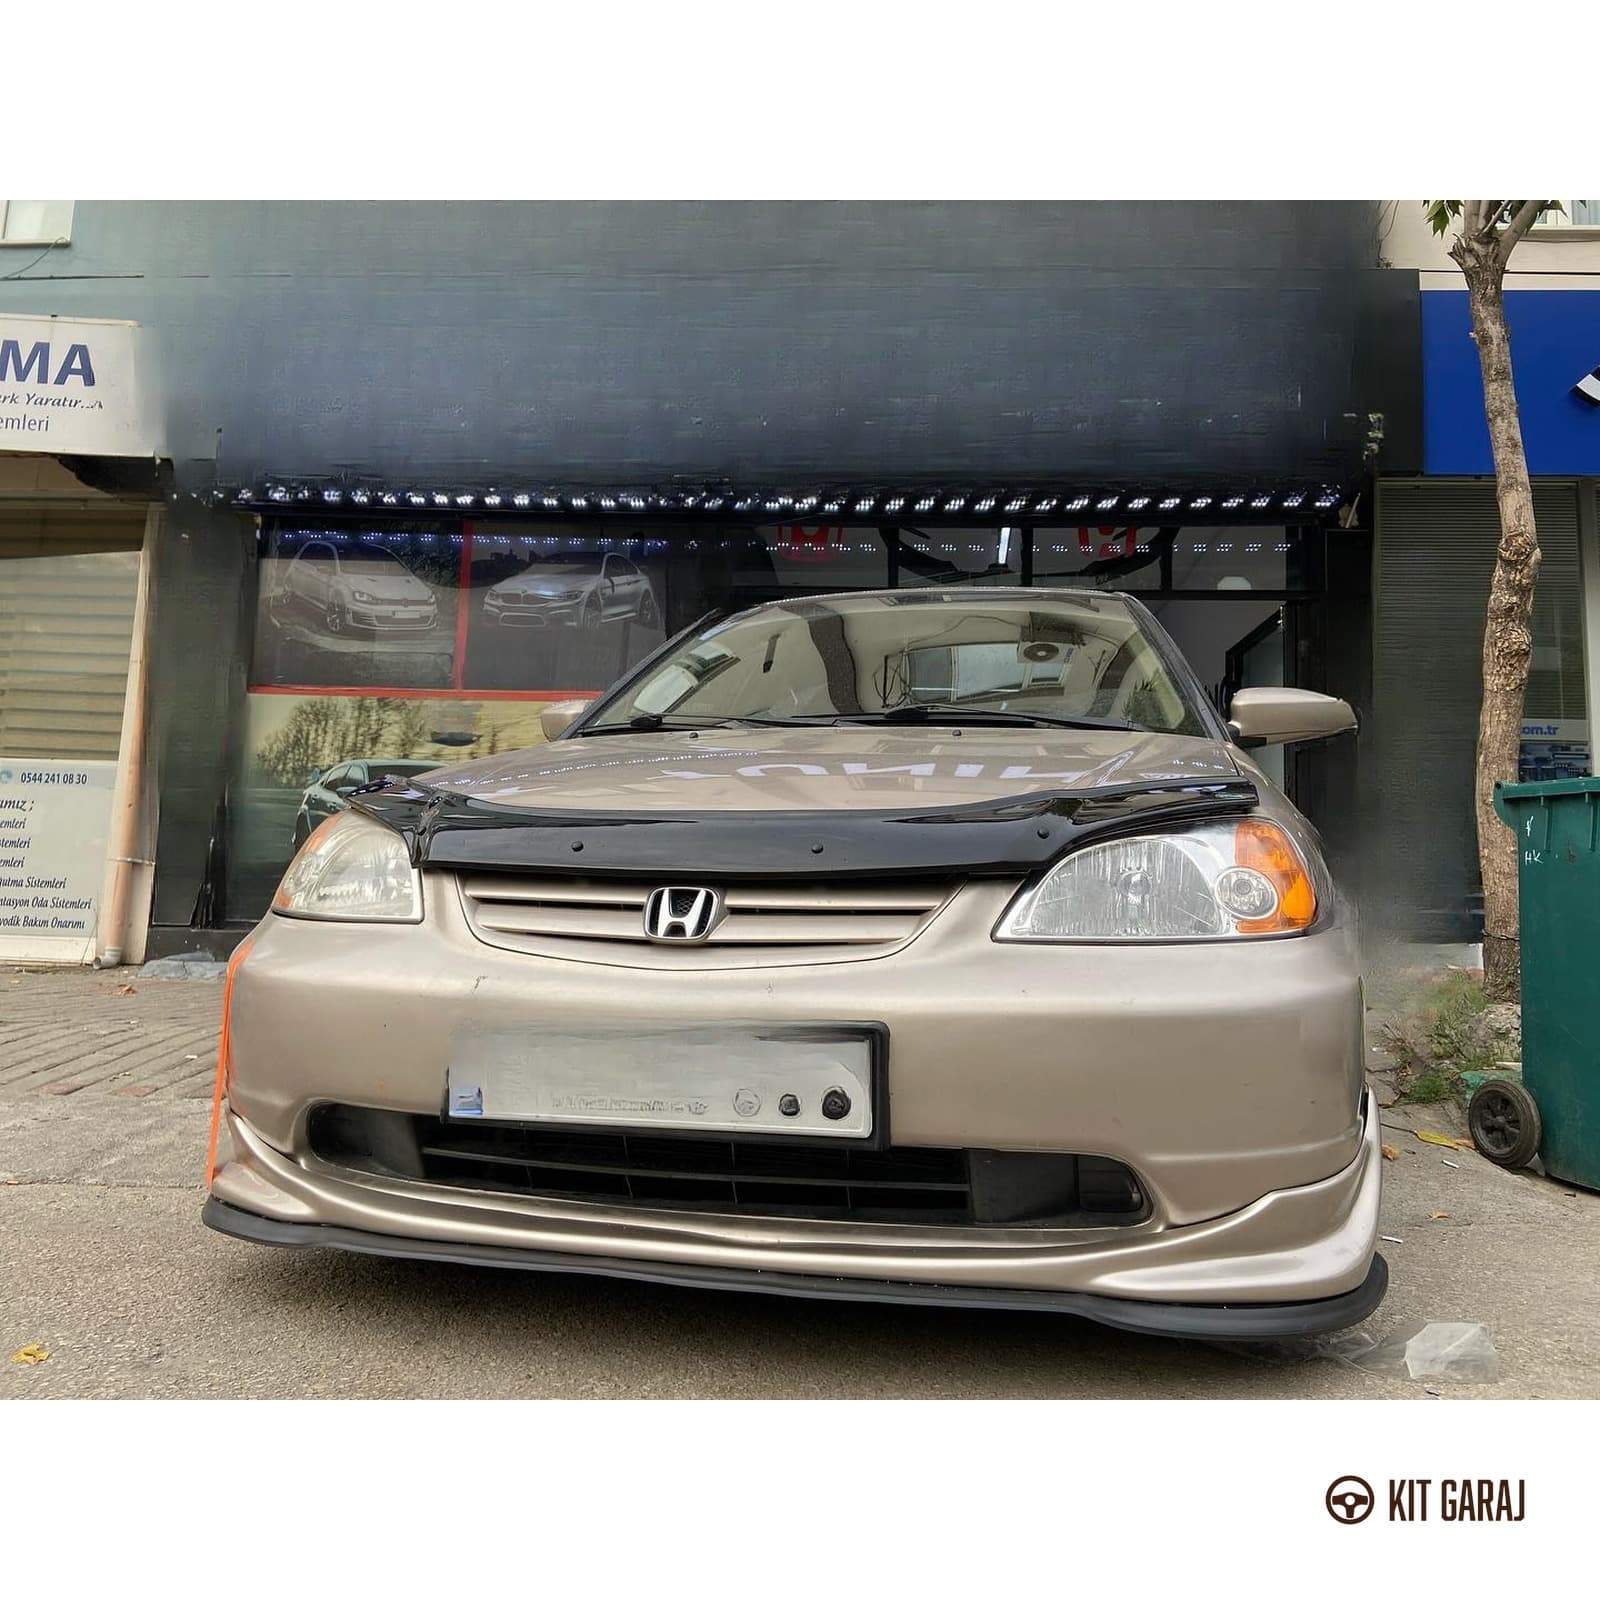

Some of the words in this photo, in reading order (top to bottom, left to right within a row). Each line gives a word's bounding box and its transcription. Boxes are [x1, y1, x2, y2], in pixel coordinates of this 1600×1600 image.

[0, 339, 95, 387] MA
[0, 393, 19, 405] rk
[20, 772, 43, 784] 0544
[44, 773, 60, 784] 241
[62, 773, 74, 785] 08
[76, 774, 88, 785] 30
[25, 876, 67, 889] Sistemleri
[32, 896, 48, 908] Oda
[50, 897, 92, 910] Sistemleri
[22, 916, 49, 929] Bakım
[51, 917, 85, 929] Onarımı
